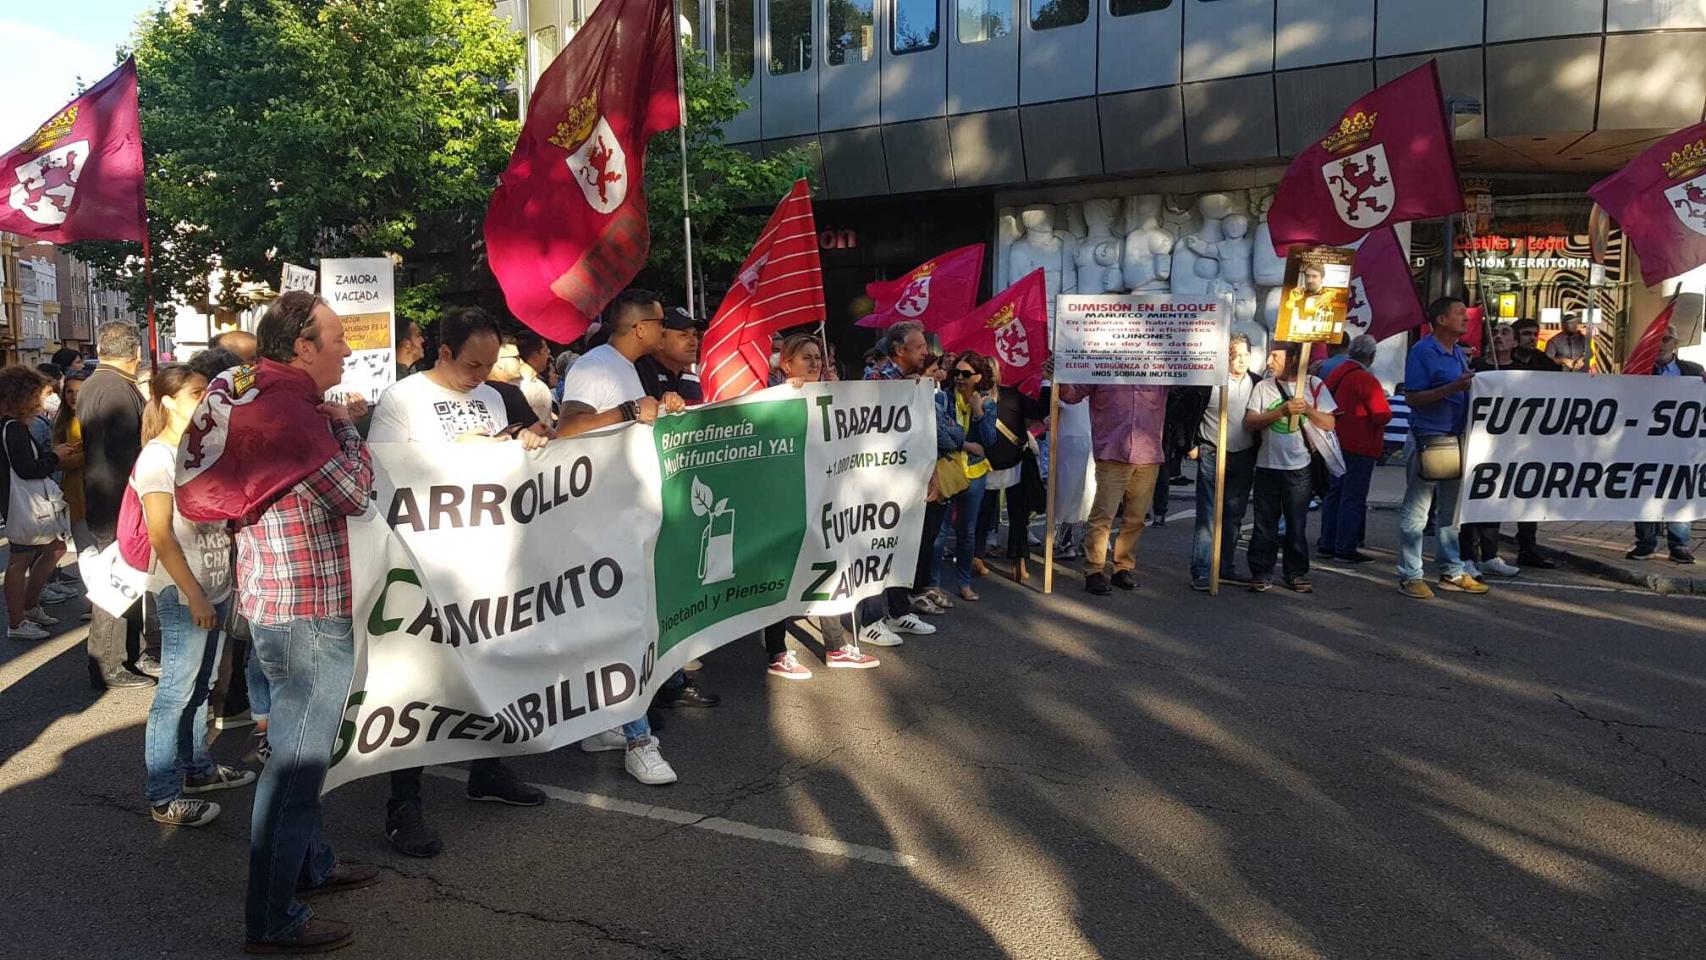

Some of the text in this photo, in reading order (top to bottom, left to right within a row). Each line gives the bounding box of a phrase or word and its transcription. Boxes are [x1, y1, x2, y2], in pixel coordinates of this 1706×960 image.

[1510, 257, 1590, 268] TERRITORIA
[336, 274, 378, 285] ZAMORA
[335, 291, 379, 302] VACIADA
[1137, 303, 1154, 312] EN
[1160, 303, 1217, 312] BLOQUE
[816, 395, 912, 442] TRABAJO
[1472, 396, 1619, 436] FUTURO
[662, 419, 754, 451] Biorrefinería
[664, 437, 794, 477] Multifuncional YA!
[850, 450, 908, 469] EMPLEOS
[370, 456, 592, 532] ARROLLO
[822, 501, 901, 550] FUTURO
[871, 536, 899, 550] PARA
[712, 594, 721, 611] y
[725, 579, 785, 602] Piensos
